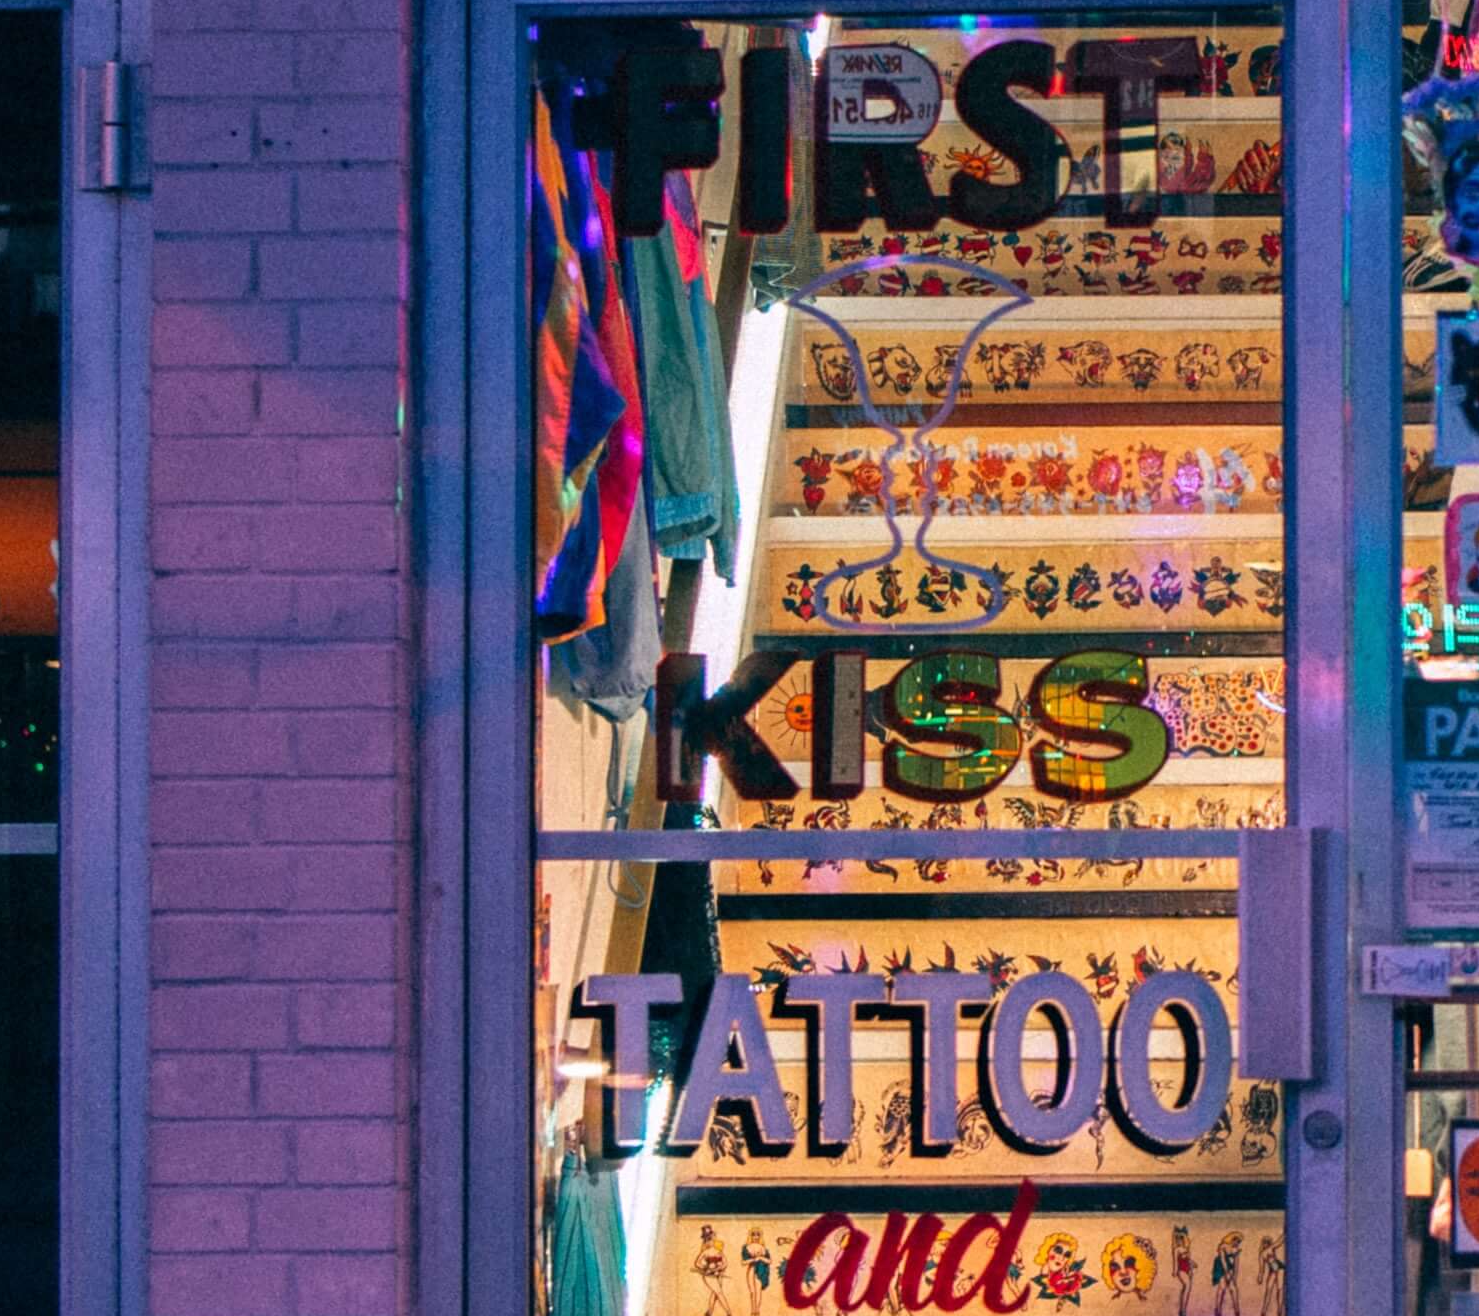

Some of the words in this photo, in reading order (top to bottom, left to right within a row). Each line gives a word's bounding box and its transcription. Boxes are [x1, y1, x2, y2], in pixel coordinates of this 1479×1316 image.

[572, 38, 1209, 234] FIRST
[653, 647, 1169, 803] KISS
[571, 970, 1232, 1160] TATTOO
[785, 1178, 1040, 1315] and
